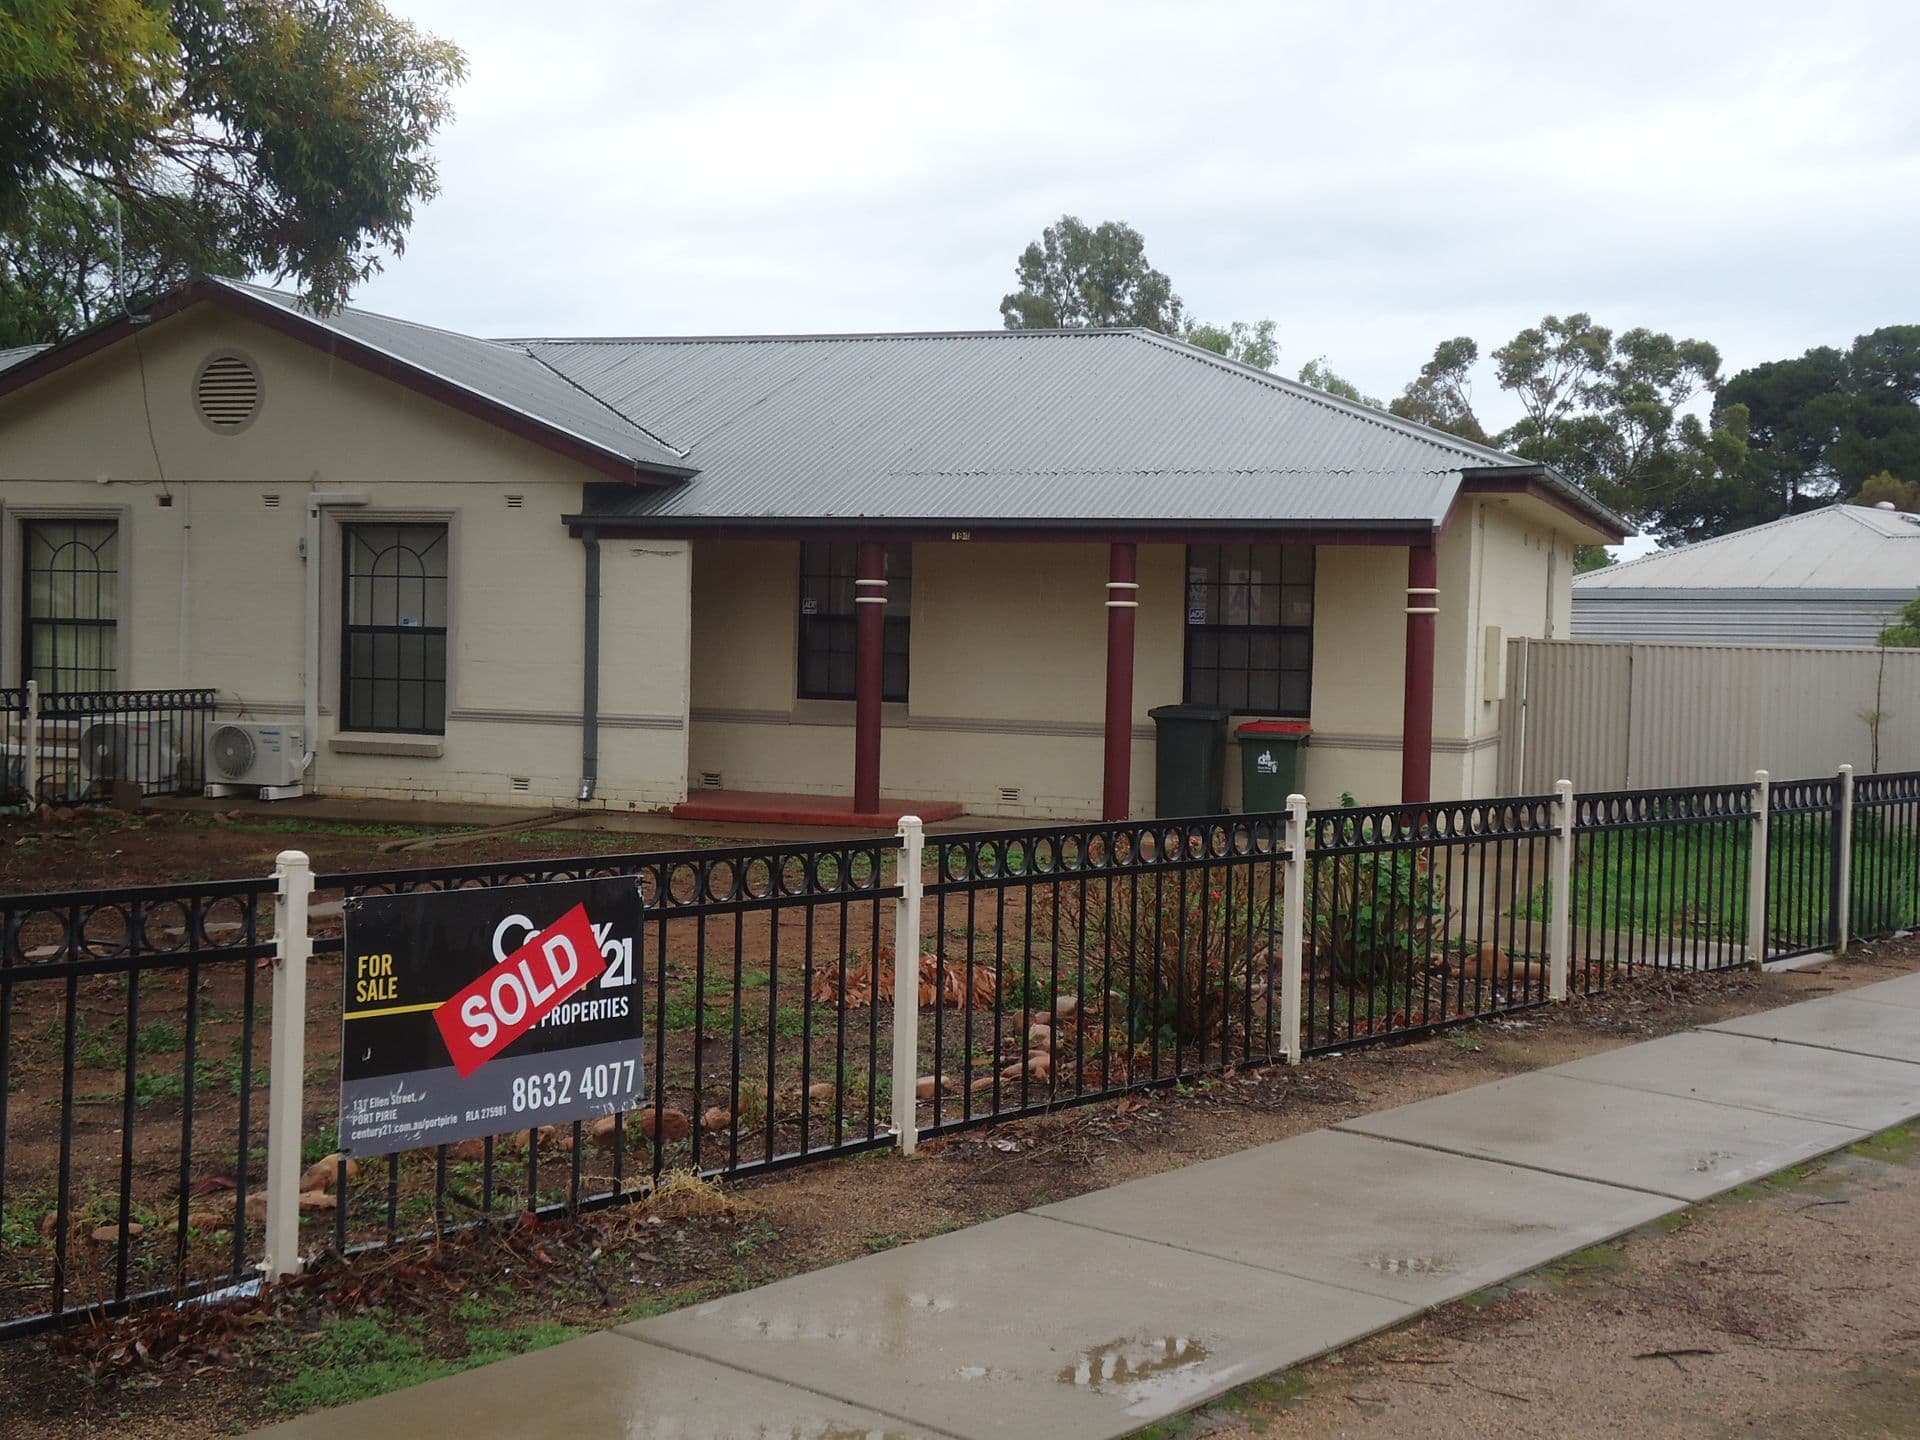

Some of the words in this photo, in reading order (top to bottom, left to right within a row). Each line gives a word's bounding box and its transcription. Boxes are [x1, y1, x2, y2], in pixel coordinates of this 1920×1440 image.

[357, 954, 393, 979] FOR
[600, 937, 633, 989] 21
[356, 976, 398, 1003] SALE
[461, 934, 578, 1048] SOLD
[512, 1070, 572, 1113] 8632
[579, 1060, 636, 1101] 4077
[369, 1097, 390, 1109] Ellen
[465, 1110, 480, 1122] RLA
[352, 1112, 374, 1126] PORT
[375, 1109, 398, 1122] PIRIE
